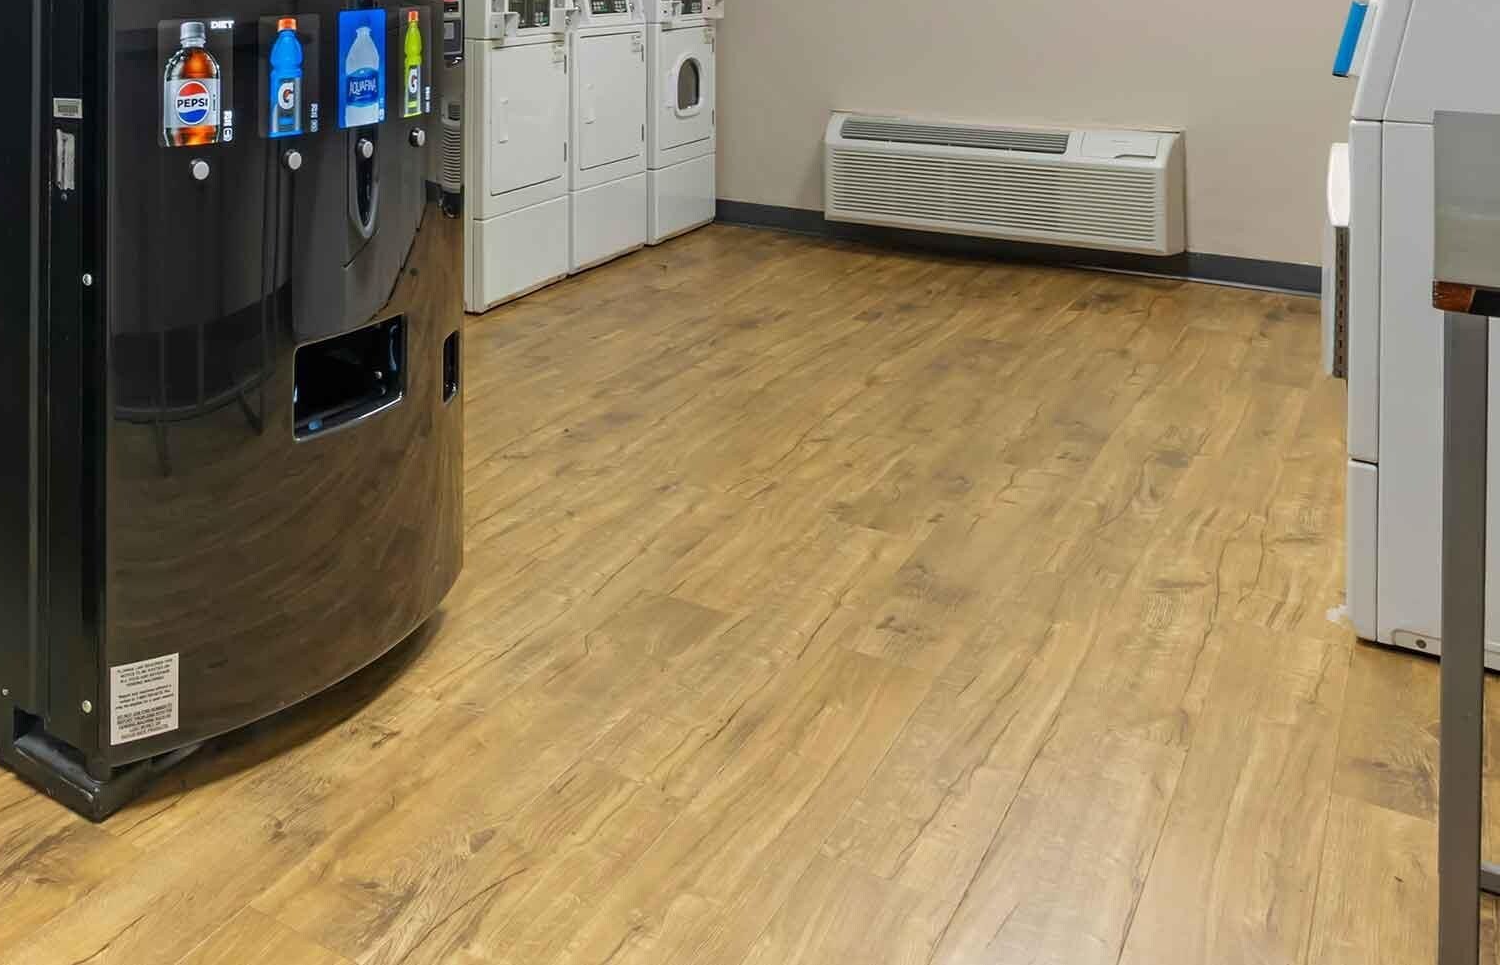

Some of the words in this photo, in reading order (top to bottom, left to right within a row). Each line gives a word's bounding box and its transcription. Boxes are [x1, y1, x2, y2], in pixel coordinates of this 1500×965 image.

[210, 20, 234, 29] DIET
[409, 67, 417, 93] G
[177, 98, 208, 108] PEPSI
[278, 82, 294, 109] G
